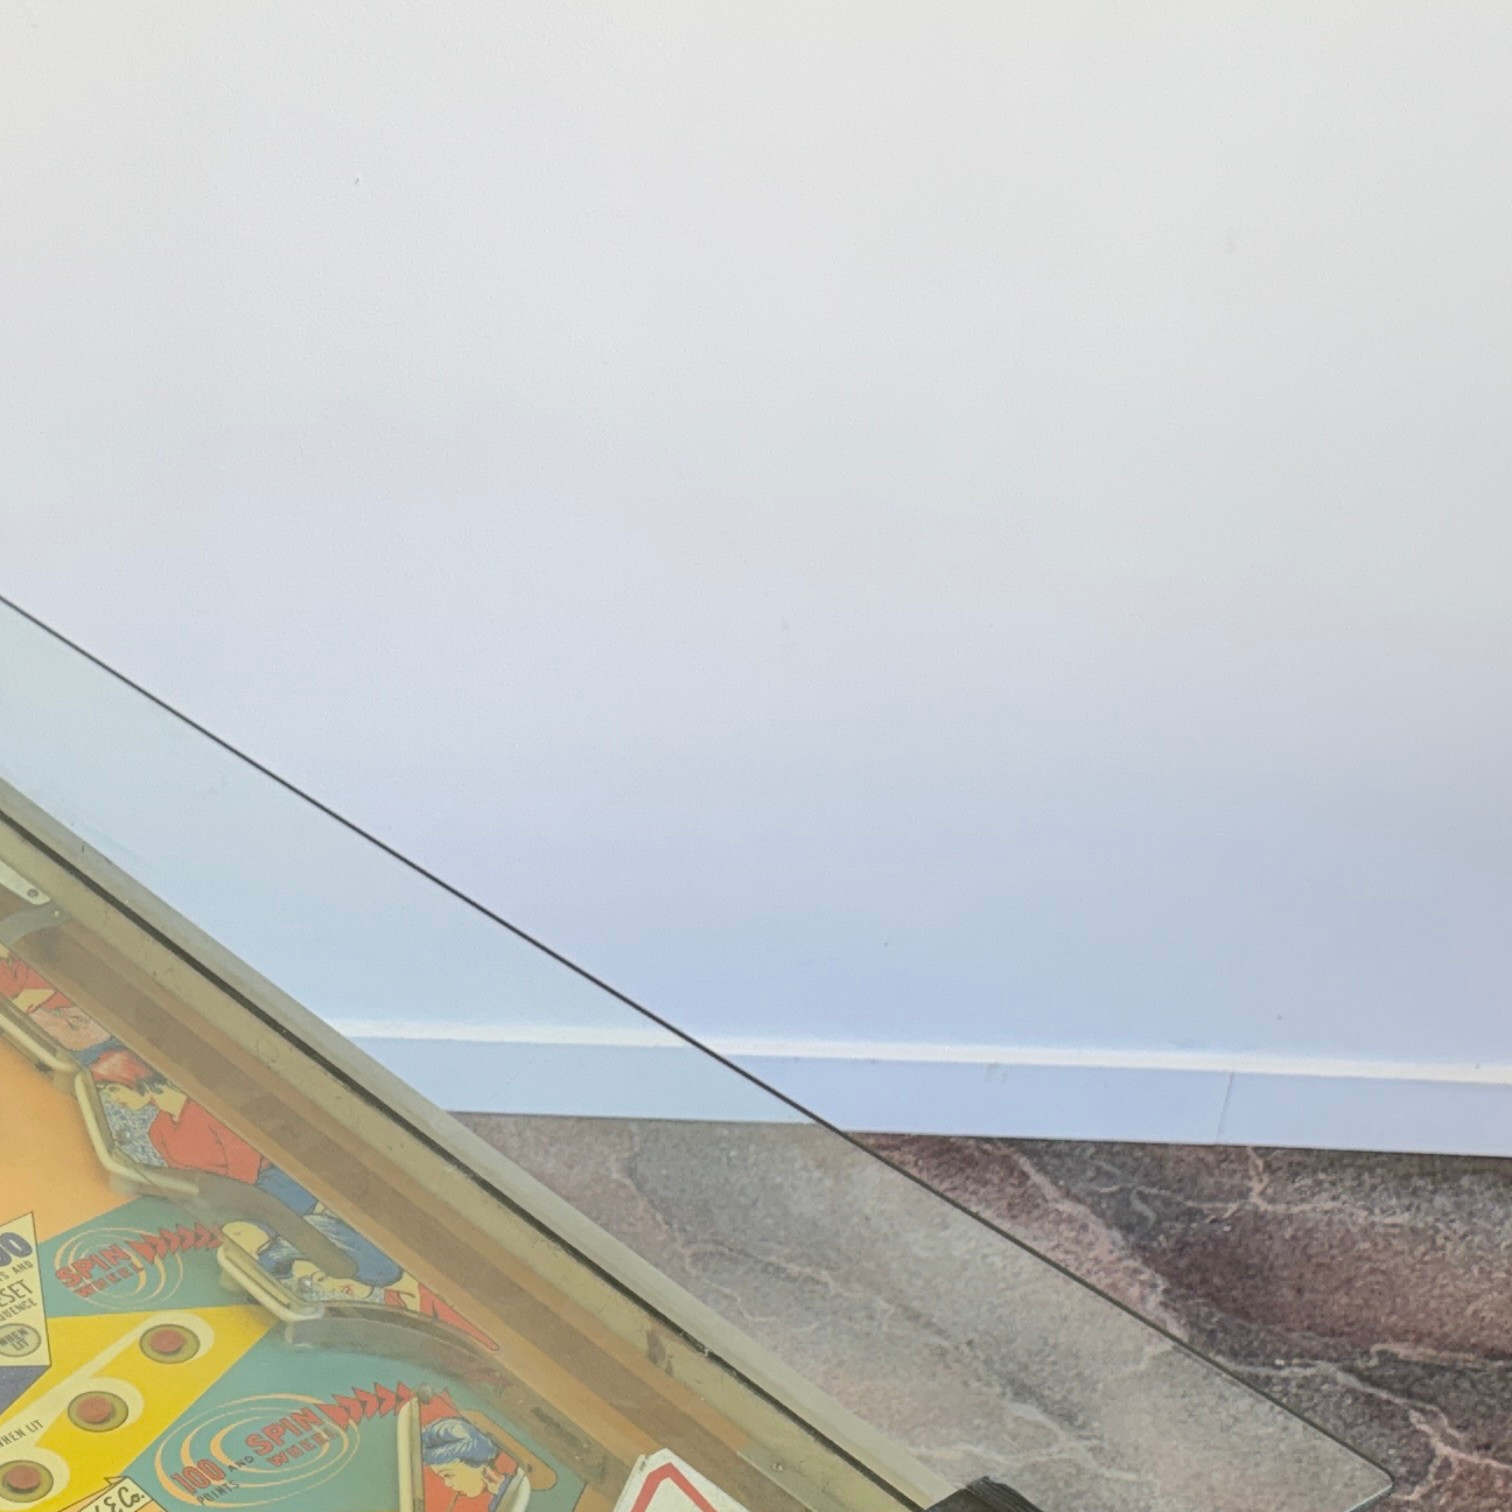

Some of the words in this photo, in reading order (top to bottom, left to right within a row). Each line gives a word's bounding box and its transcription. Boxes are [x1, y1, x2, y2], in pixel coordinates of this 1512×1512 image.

[12, 1260, 34, 1277] AND
[54, 1243, 132, 1289] SPIN
[72, 1262, 146, 1299] WHEEL
[12, 1339, 31, 1352] LIT
[26, 1418, 45, 1434] LIT
[244, 1407, 326, 1457] SPIN
[266, 1427, 341, 1468] WHEEL
[171, 1458, 227, 1497] 100
[228, 1454, 255, 1473] AND
[116, 1485, 146, 1509] Co.
[195, 1479, 240, 1506] POINTS
